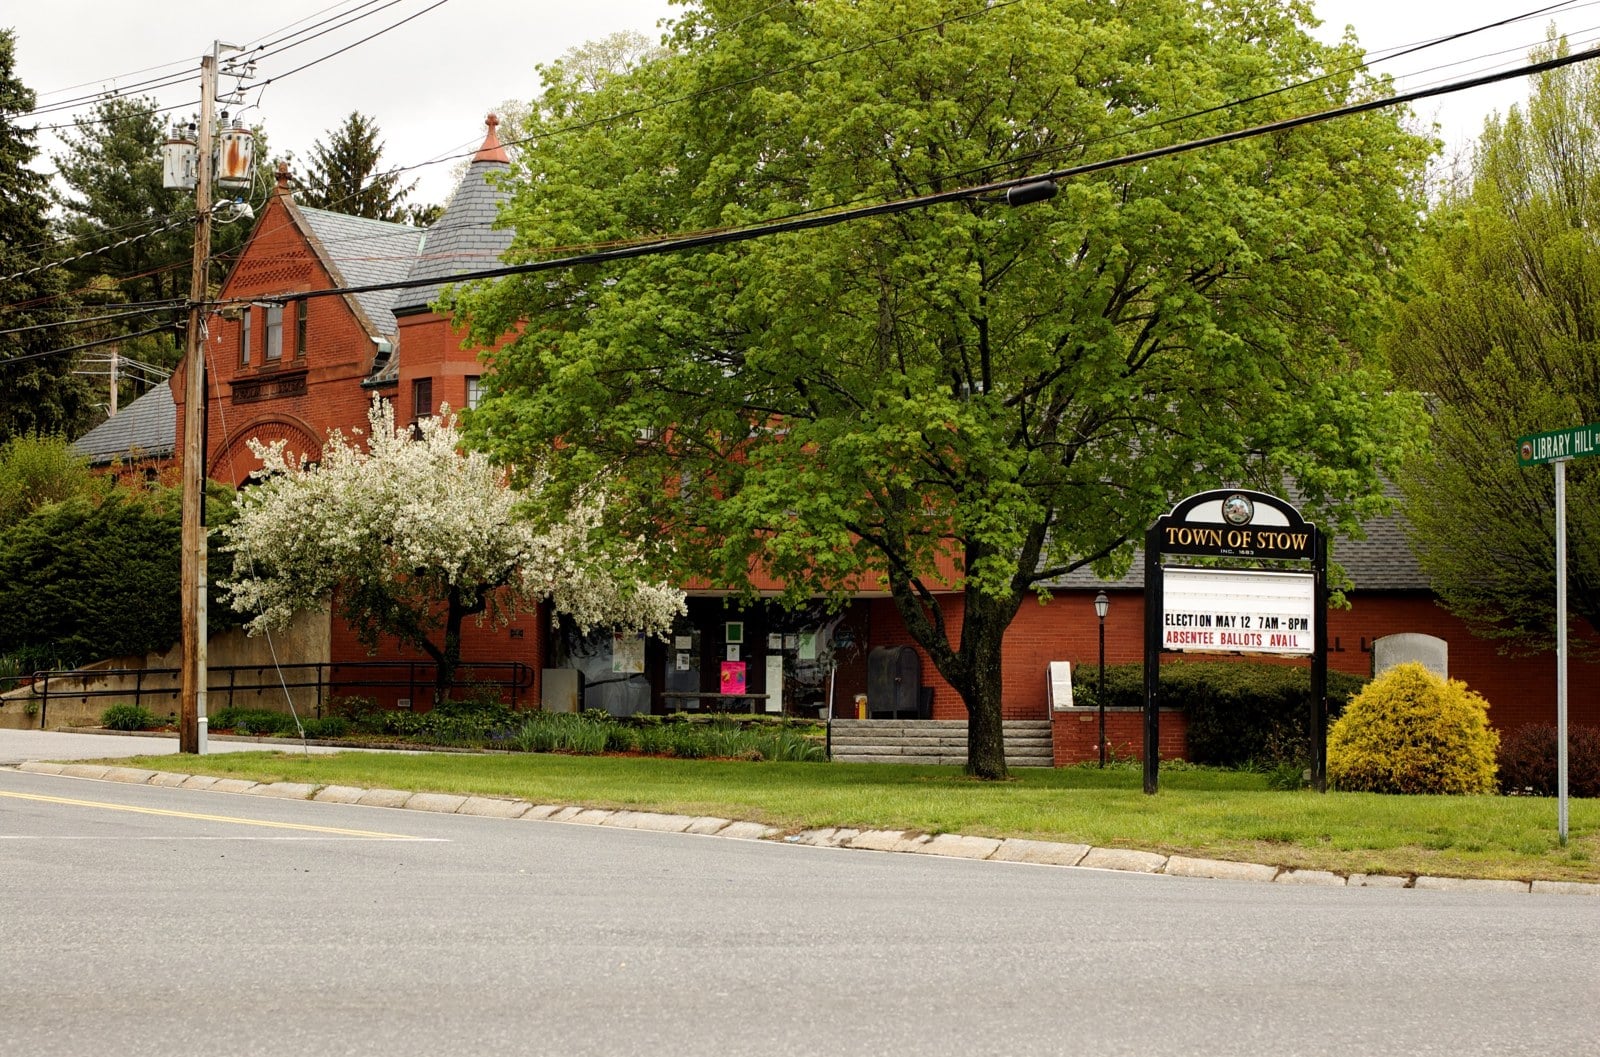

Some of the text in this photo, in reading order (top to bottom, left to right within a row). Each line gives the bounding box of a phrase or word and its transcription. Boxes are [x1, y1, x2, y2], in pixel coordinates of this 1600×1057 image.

[1532, 433, 1571, 460] LIBRARY
[1574, 429, 1594, 453] HILL
[1165, 527, 1309, 551] TOWN OF STOW
[1165, 613, 1212, 627] ELECTION
[1215, 615, 1237, 628] MAY
[1240, 616, 1251, 629] 12
[1166, 630, 1299, 647] ABSENTEE BALLOTS AVAIL
